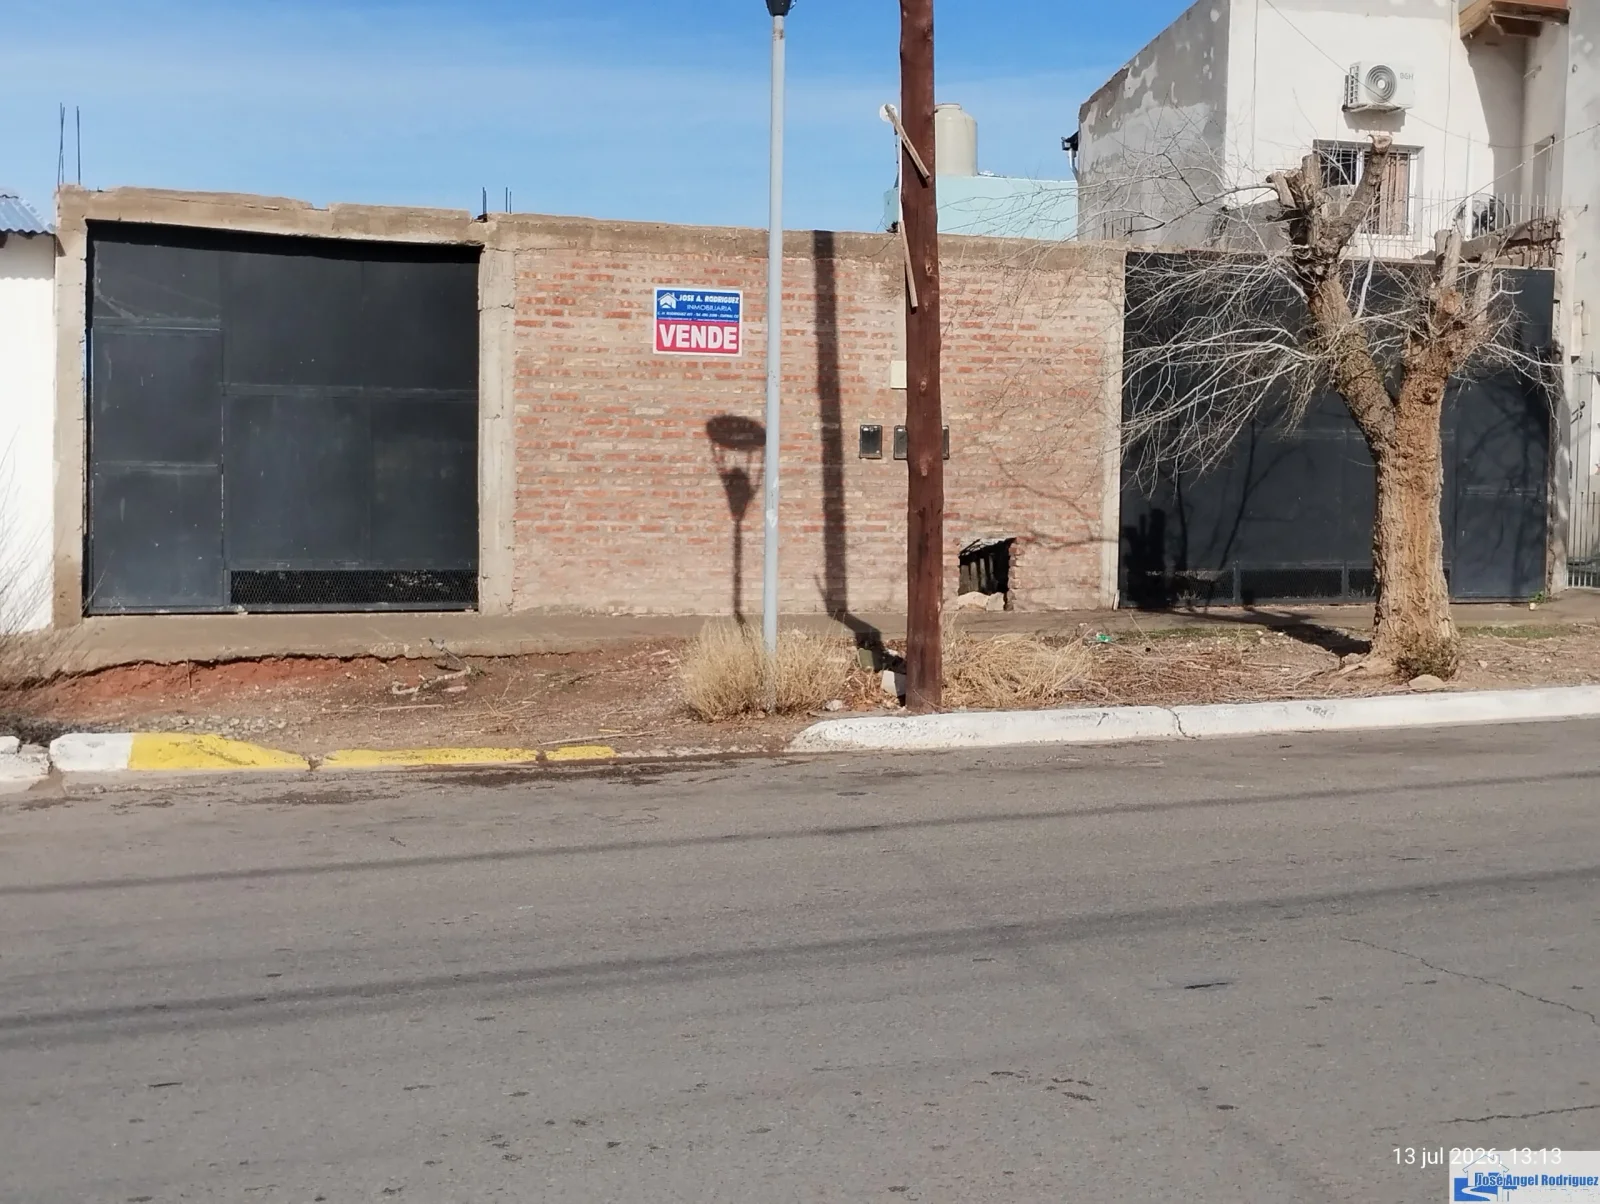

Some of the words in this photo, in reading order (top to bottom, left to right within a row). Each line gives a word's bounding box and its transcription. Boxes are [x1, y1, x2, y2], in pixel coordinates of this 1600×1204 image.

[1400, 72, 1414, 80] BGH
[679, 294, 694, 302] JOSE
[705, 295, 739, 304] RODRIGUEZ
[687, 304, 732, 312] INMOBILIARIA
[659, 324, 737, 349] VENDE
